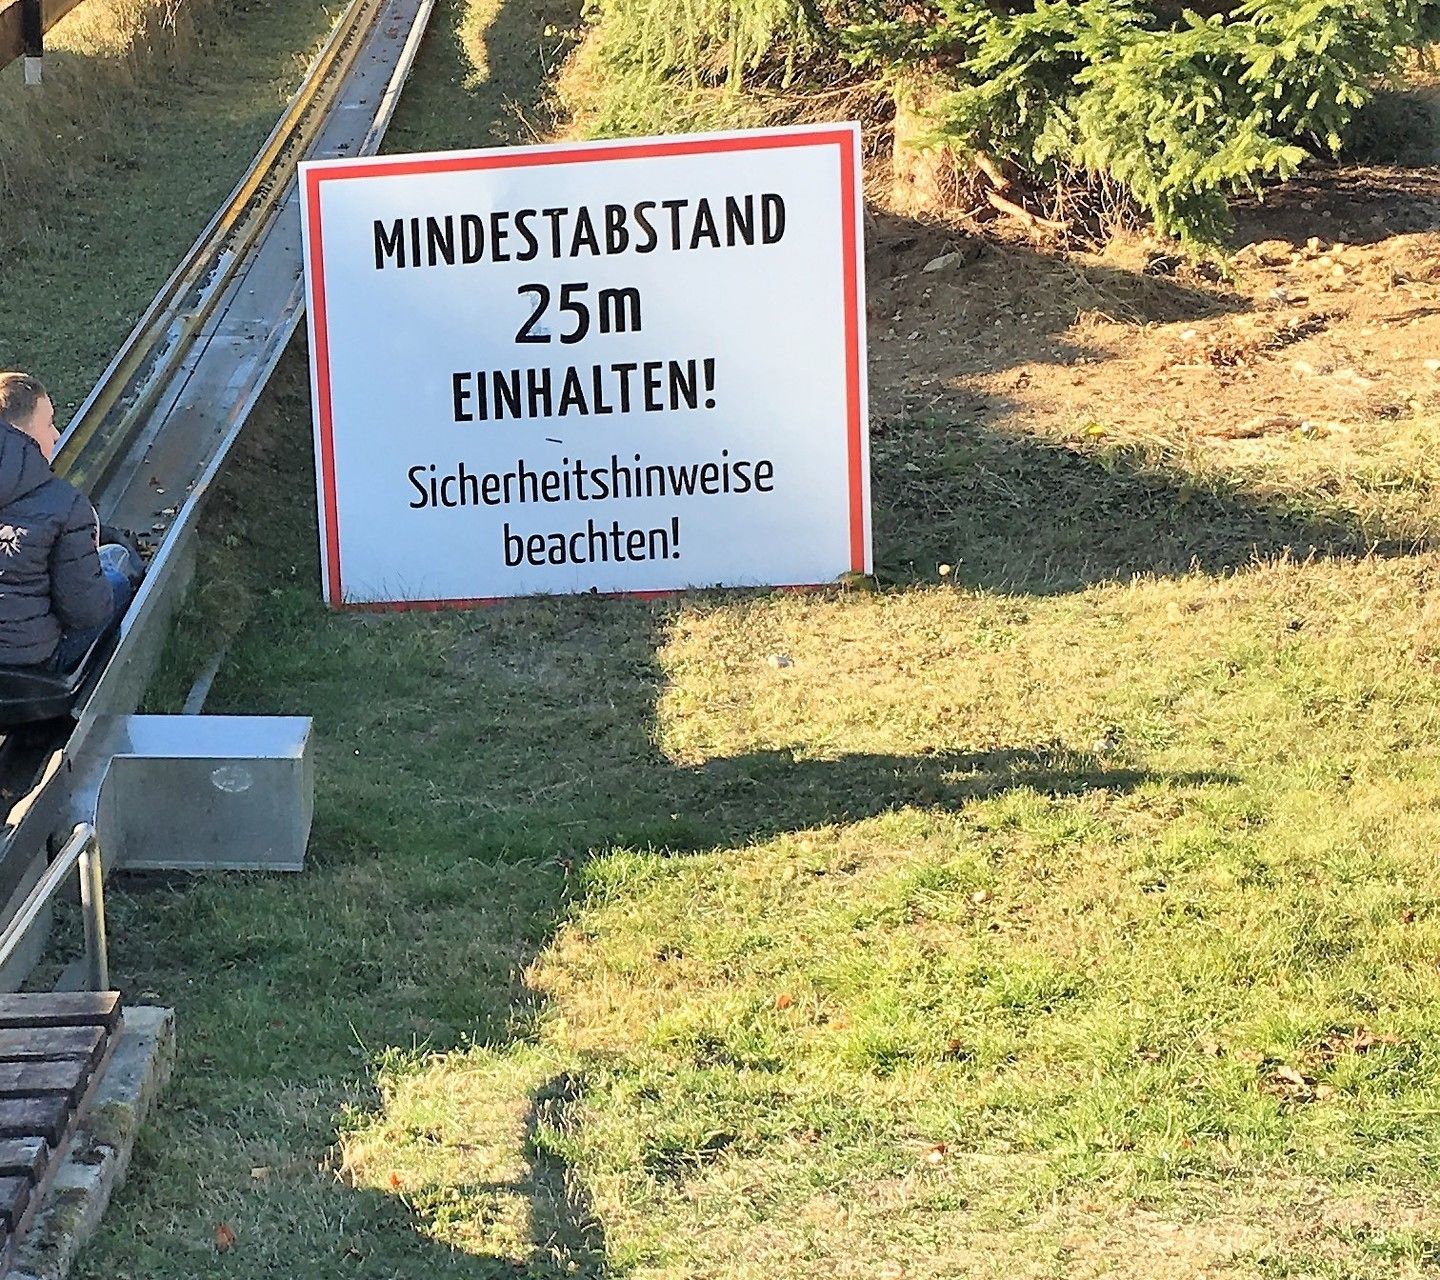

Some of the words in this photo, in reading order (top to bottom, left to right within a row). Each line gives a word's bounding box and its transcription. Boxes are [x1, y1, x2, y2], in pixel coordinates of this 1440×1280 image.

[373, 193, 786, 270] MINDESTABSTAND
[515, 282, 642, 345] 25m
[452, 357, 716, 422] EINHALTEN!
[407, 449, 774, 509] Sicherheitshinweise
[503, 516, 680, 567] beachten!
